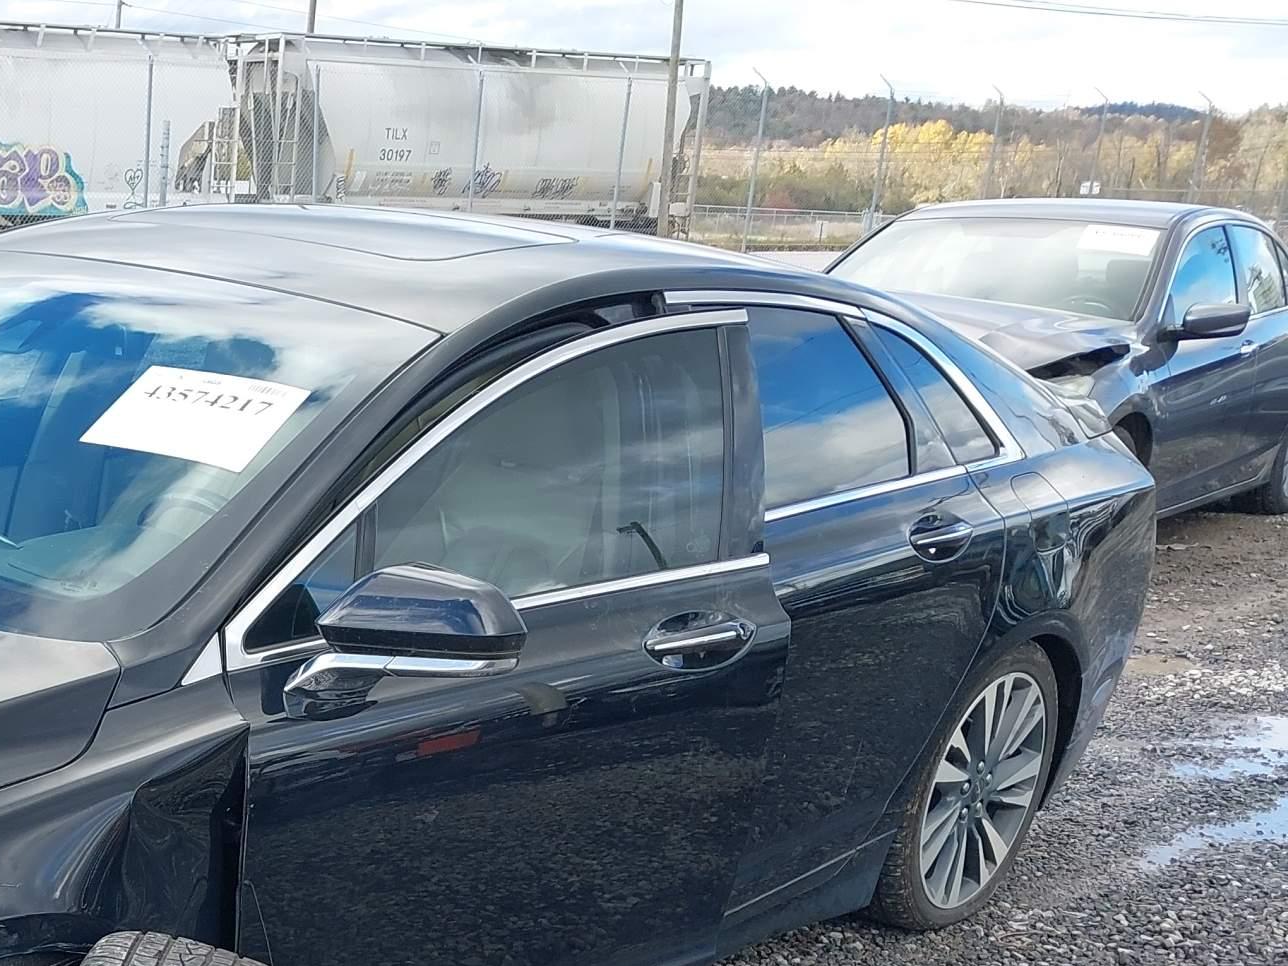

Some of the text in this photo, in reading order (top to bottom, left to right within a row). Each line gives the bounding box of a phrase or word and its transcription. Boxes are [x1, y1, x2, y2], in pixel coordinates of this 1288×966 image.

[385, 128, 408, 140] TILX
[379, 148, 412, 161] 30197
[144, 385, 274, 415] 43574217
